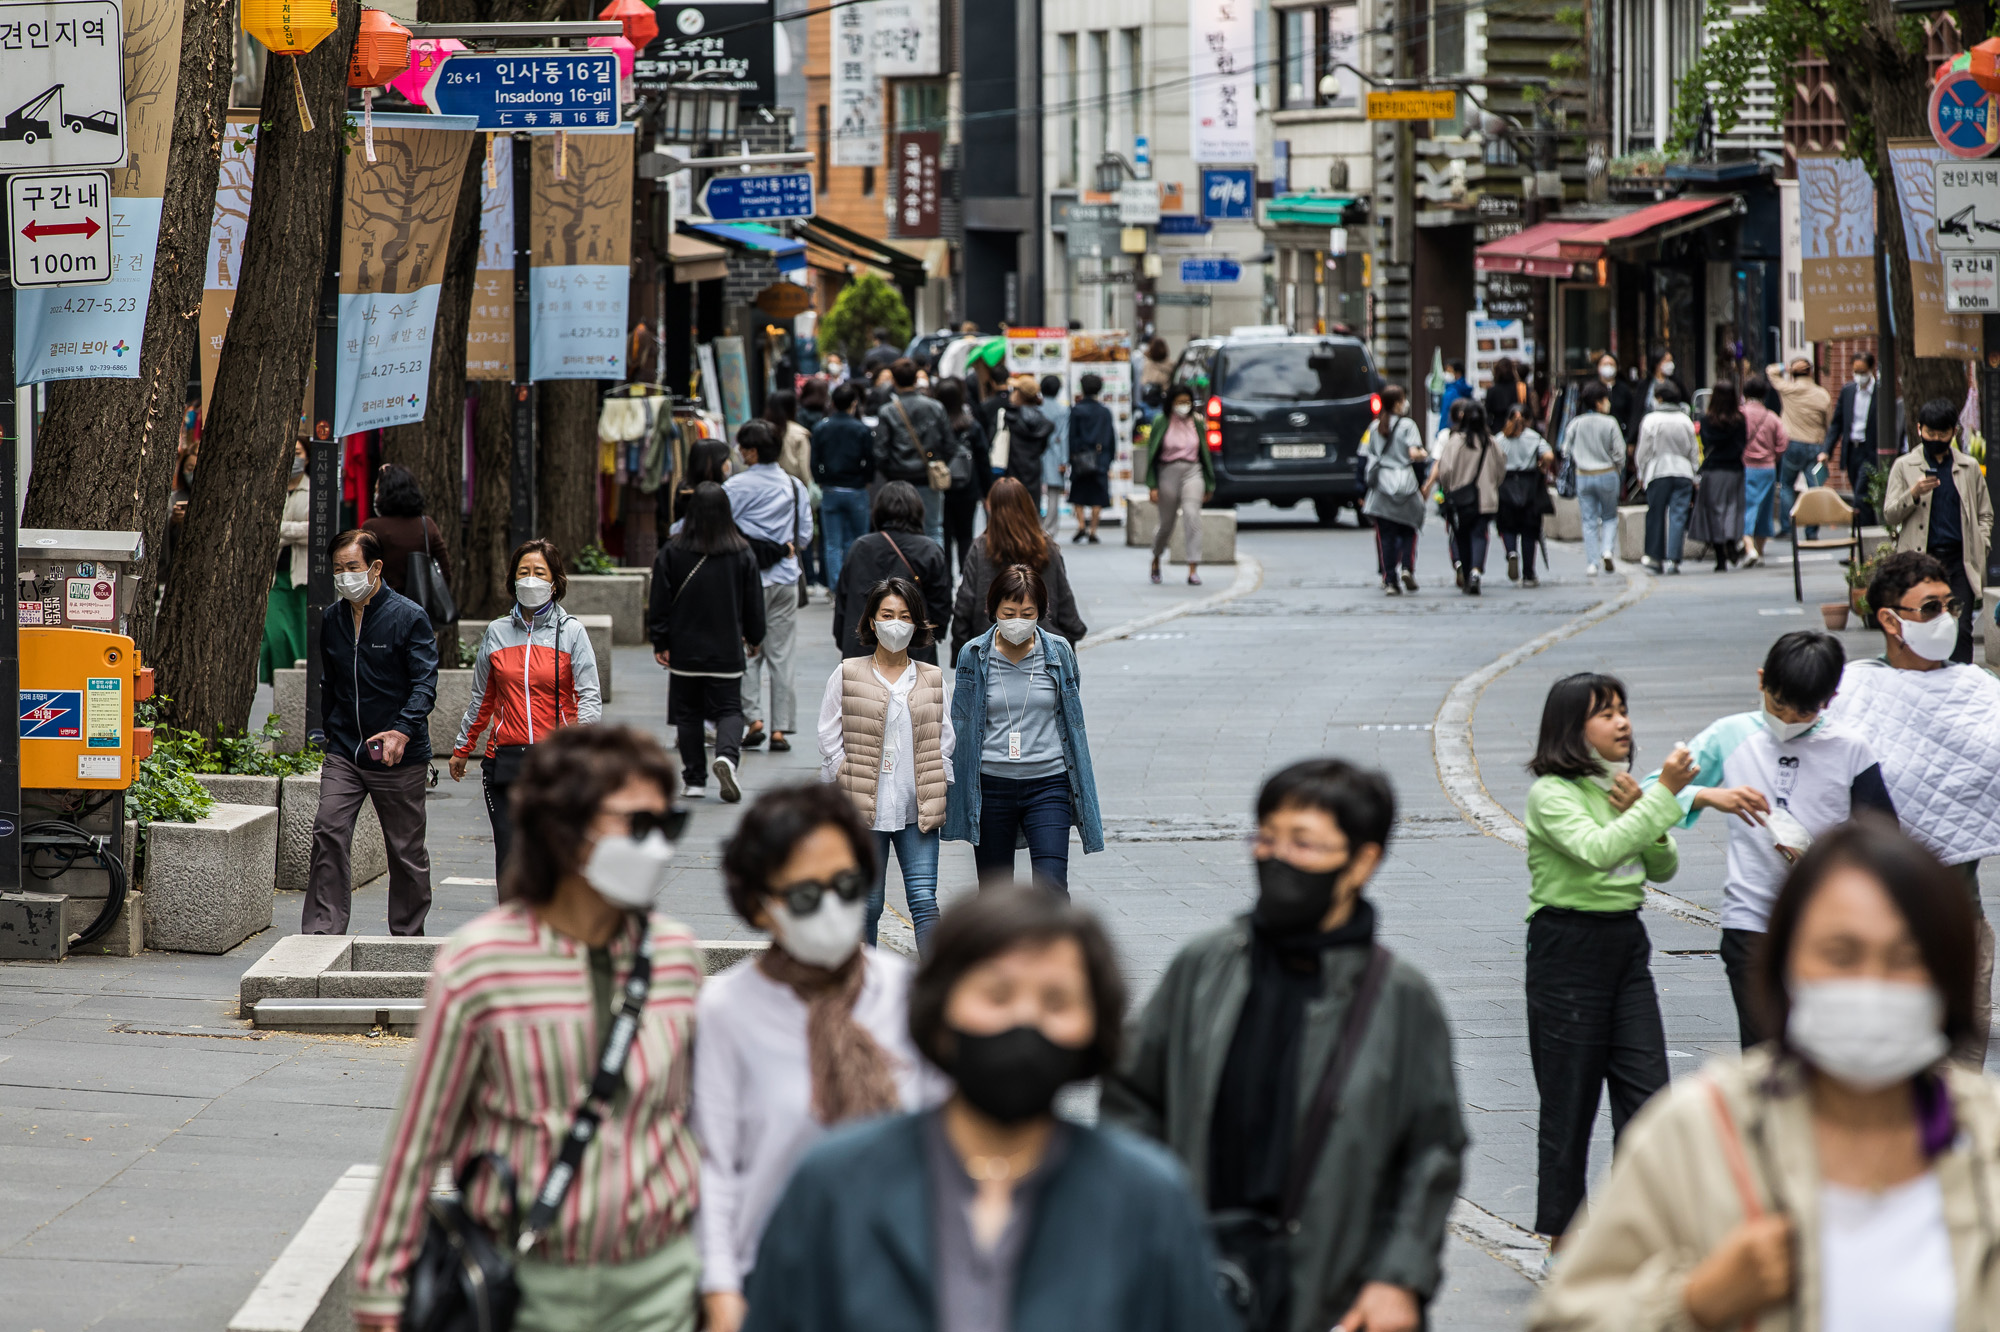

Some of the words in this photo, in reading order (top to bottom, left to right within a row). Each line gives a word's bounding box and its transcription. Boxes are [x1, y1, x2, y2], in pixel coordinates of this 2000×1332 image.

[0, 18, 104, 49] 견인지역
[447, 73, 463, 84] 26
[496, 61, 611, 84] 인사동16길
[495, 90, 563, 105] Insadong
[570, 88, 611, 104] 16-gil
[1941, 105, 1985, 121] 주정차금
[1942, 169, 1998, 187] 견인지역
[22, 183, 98, 211] 구간내
[30, 253, 96, 274] 100m
[1951, 258, 1993, 273] 구간내
[1958, 295, 1989, 307] 100m
[361, 300, 419, 326] 박수근
[50, 342, 77, 357] 갤러리
[80, 340, 108, 355] 보아
[362, 400, 385, 413] 갤러리
[386, 395, 404, 409] 보아
[315, 489, 328, 547] 전통문화의
[314, 553, 326, 575] 거리
[34, 709, 51, 719] 위험
